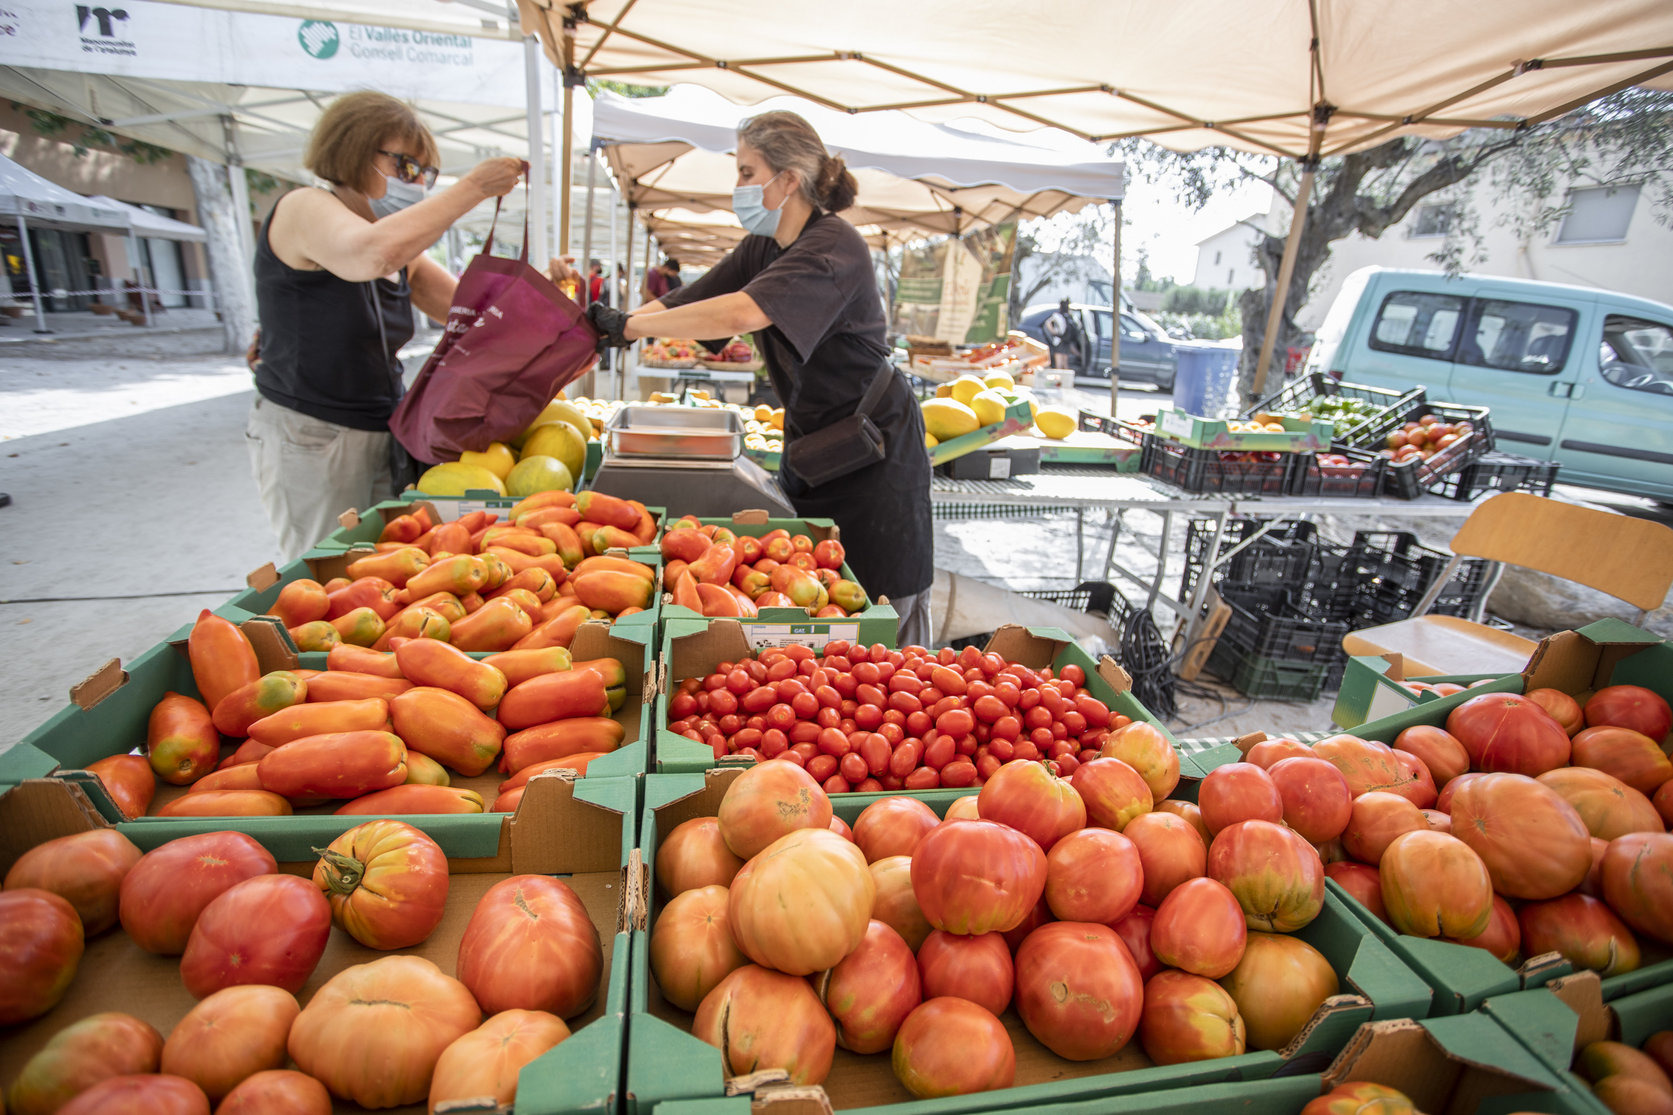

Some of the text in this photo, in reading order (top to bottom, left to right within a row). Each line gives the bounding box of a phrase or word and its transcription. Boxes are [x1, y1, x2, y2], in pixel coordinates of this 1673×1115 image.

[349, 25, 362, 40] El
[412, 30, 472, 47] Oriental
[350, 43, 473, 66] Consell Comarcal
